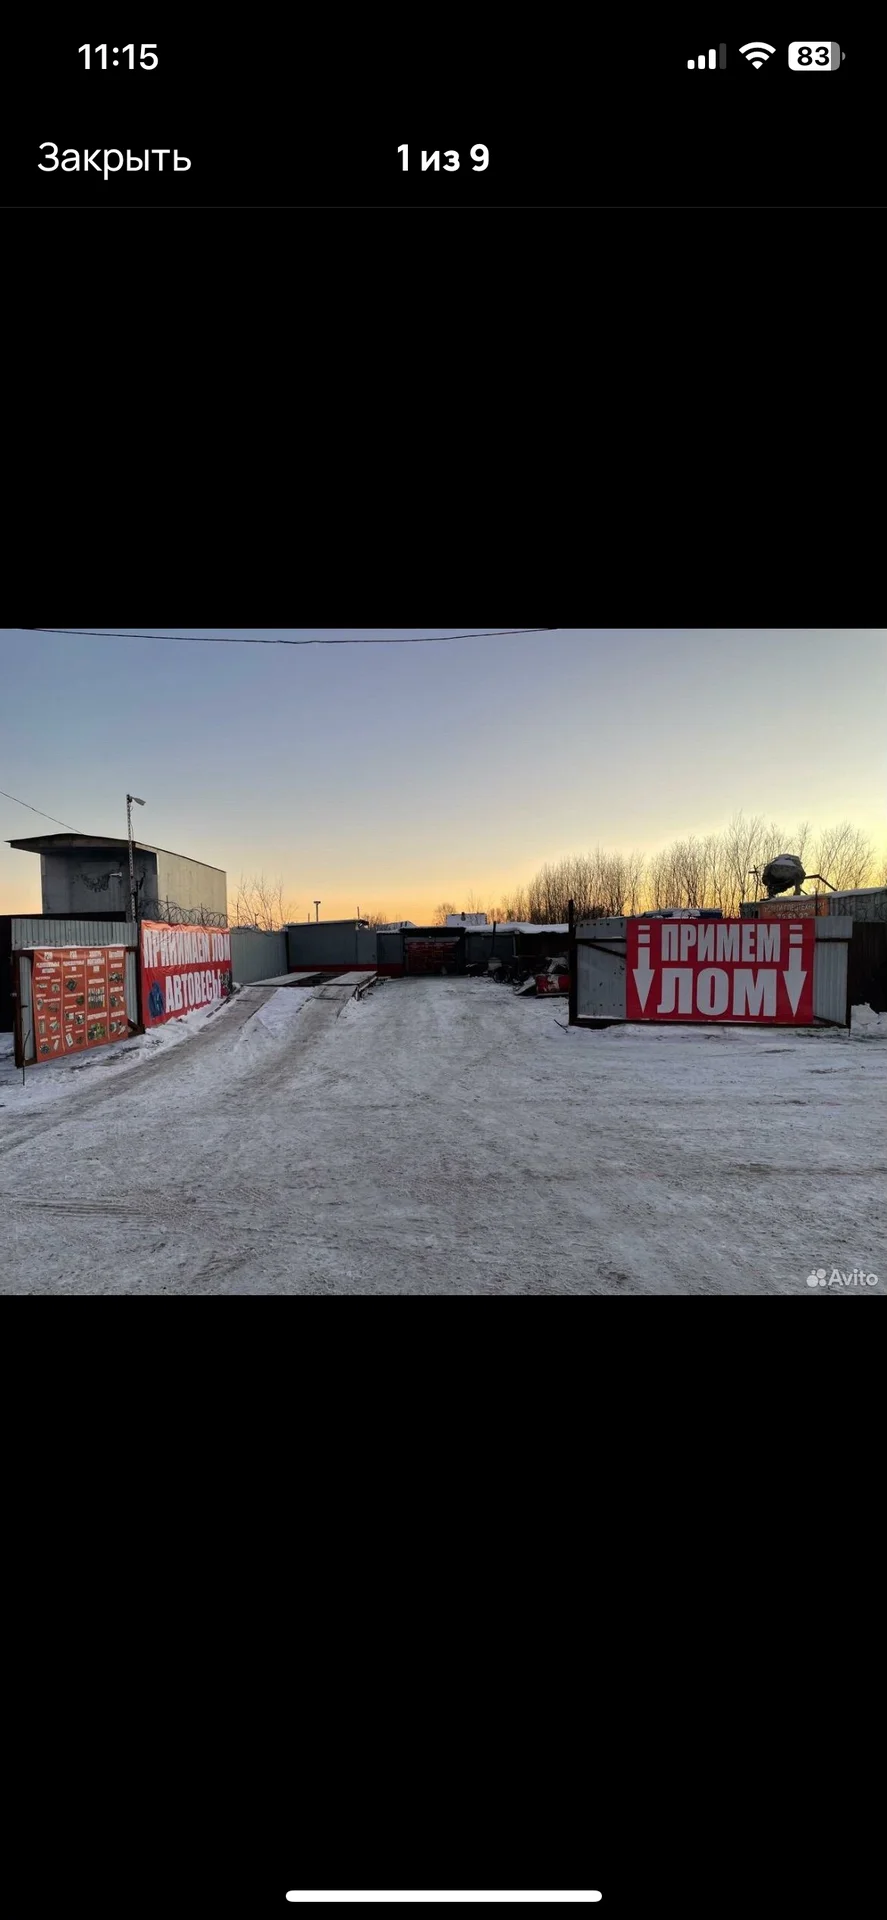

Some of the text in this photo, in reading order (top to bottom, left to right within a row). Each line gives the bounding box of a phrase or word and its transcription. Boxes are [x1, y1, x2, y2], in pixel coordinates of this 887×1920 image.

[143, 929, 211, 968] ПРИНИМАЕМ
[661, 923, 781, 962] ПРИМЕМ
[165, 969, 222, 1013] АВТОВЕСЫ
[656, 967, 778, 1018] ЛОМ
